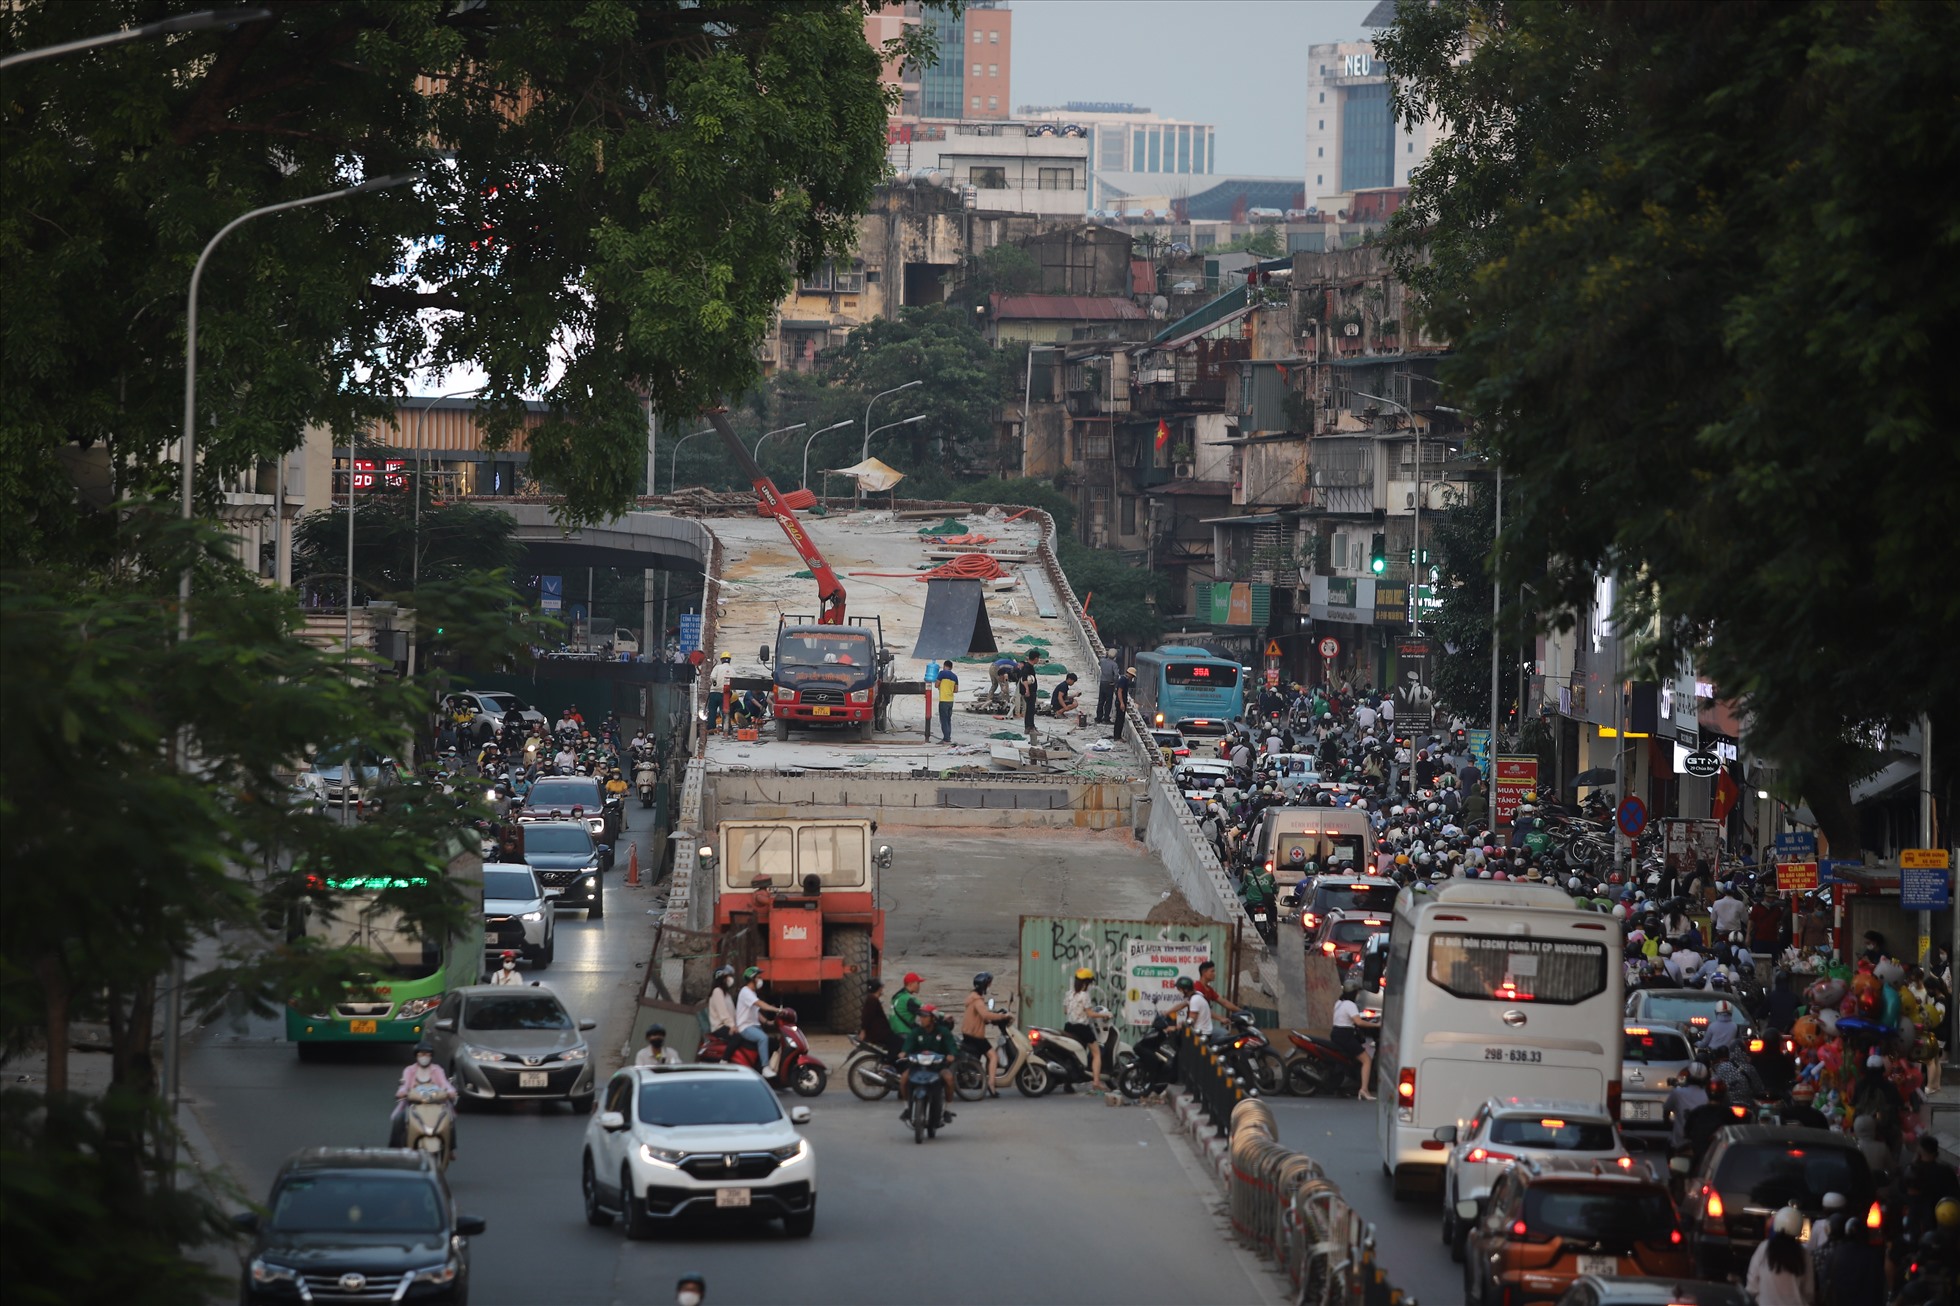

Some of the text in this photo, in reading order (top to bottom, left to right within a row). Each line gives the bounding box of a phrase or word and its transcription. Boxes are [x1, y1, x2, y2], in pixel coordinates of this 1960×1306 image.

[1344, 54, 1371, 76] NEU
[1067, 101, 1134, 113] VINACONEX
[761, 485, 777, 506] UNIC
[1193, 668, 1210, 677] 35A
[1687, 757, 1718, 765] GTM
[1251, 878, 1269, 886] Gab
[1434, 936, 1444, 946] XE
[1531, 941, 1540, 952] TY
[1541, 942, 1553, 953] CP
[1554, 943, 1602, 956] WOODSLAND
[1136, 967, 1175, 977] Trên web
[1485, 1048, 1503, 1060] 29B
[1509, 1050, 1542, 1063] 636.33
